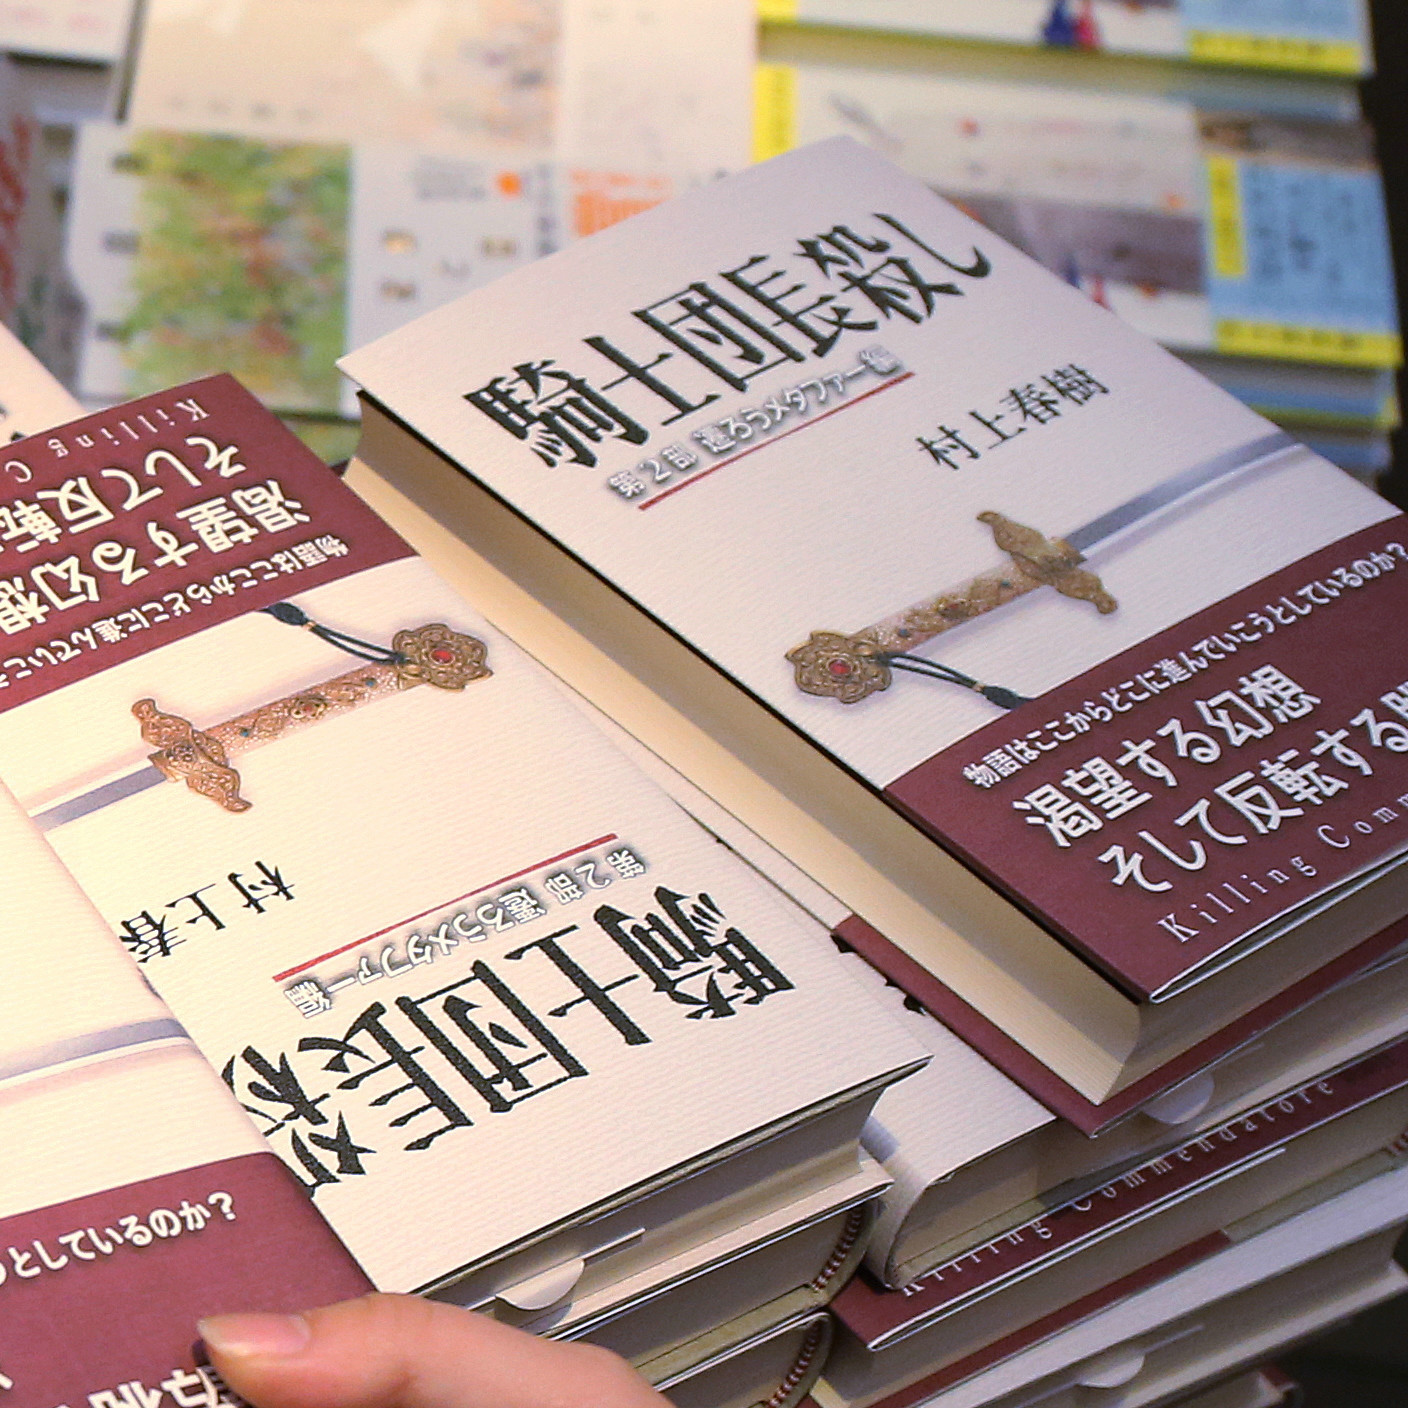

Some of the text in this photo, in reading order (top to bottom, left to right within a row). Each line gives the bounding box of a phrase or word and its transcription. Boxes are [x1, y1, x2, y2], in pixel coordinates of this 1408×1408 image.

[463, 212, 993, 469] 騎士団長殺し
[48, 399, 209, 460] Killing
[916, 362, 1113, 472] 村上春樹
[607, 445, 699, 504] 第2部
[1012, 664, 1321, 847] 渇望する幻想
[546, 849, 645, 906] 第2部
[1156, 855, 1317, 943] Killing
